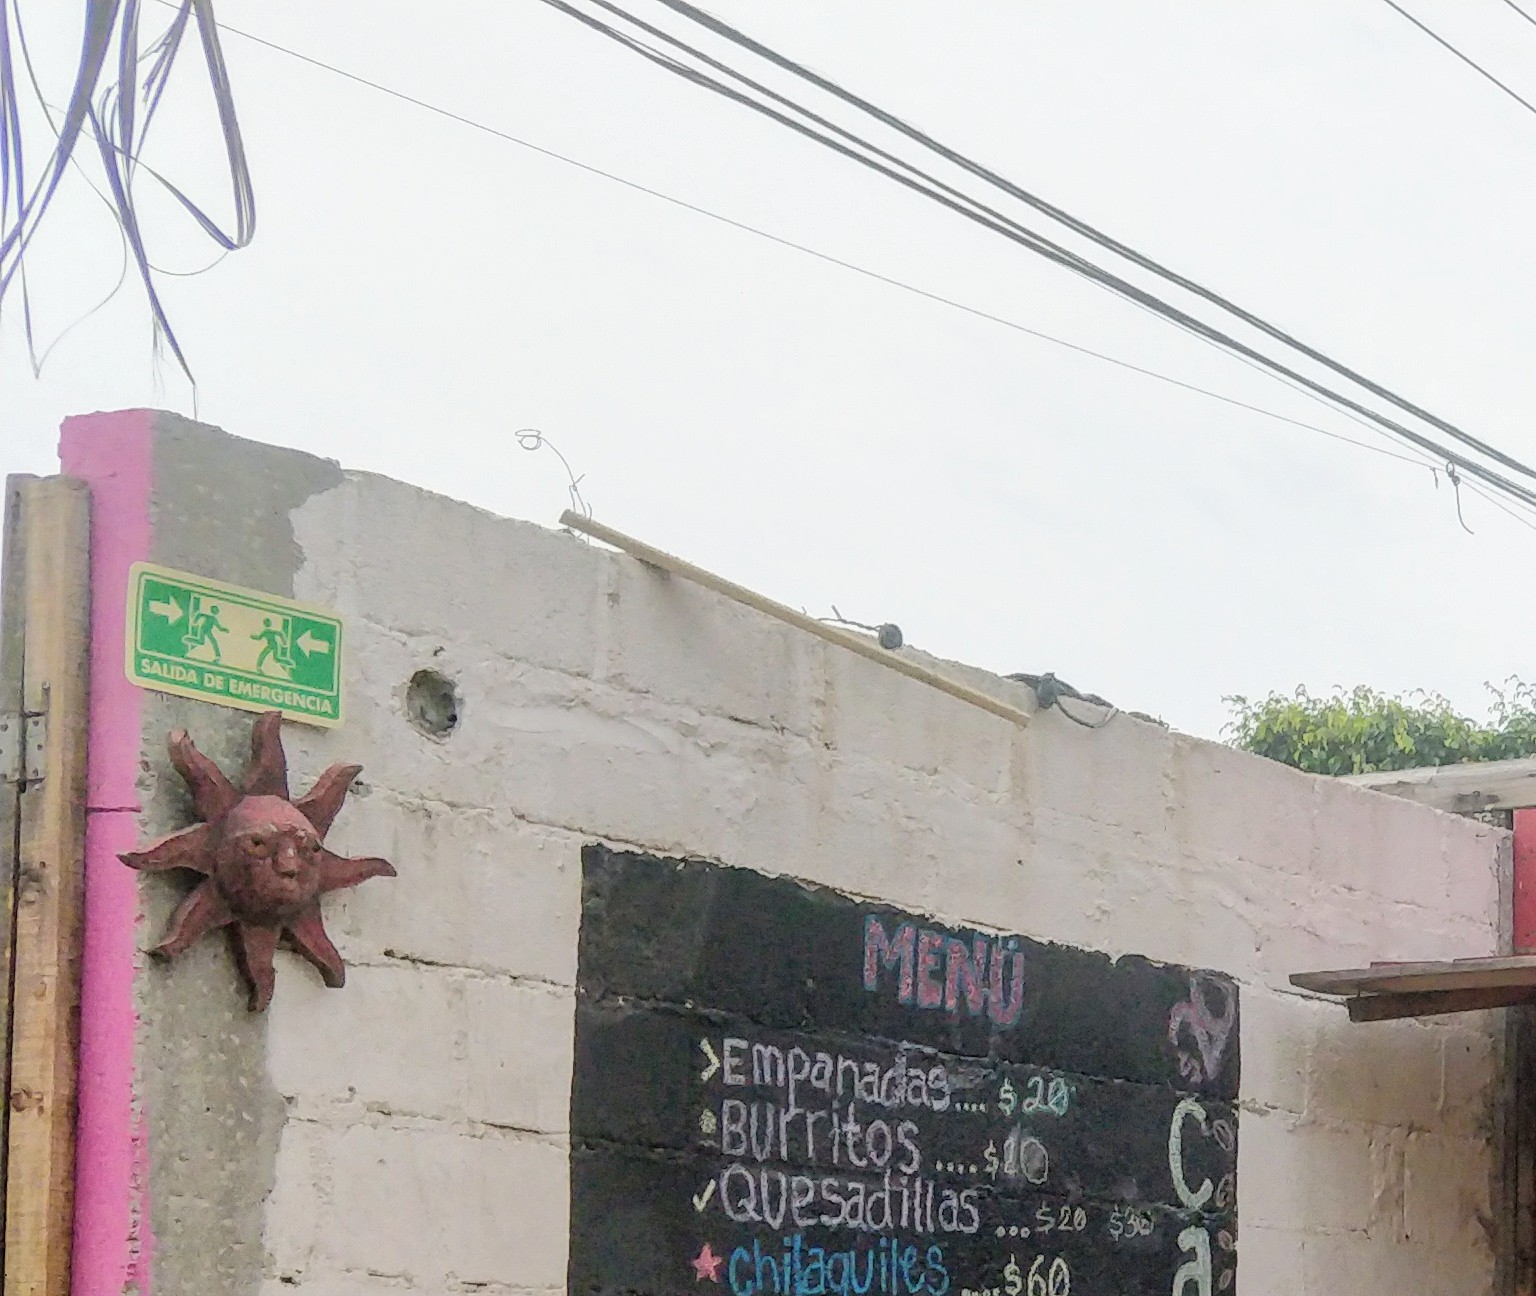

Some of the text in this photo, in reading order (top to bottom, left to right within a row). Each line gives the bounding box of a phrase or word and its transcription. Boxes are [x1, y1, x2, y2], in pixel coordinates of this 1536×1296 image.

[140, 658, 334, 715] SALIDA DE EMERGENCIA
